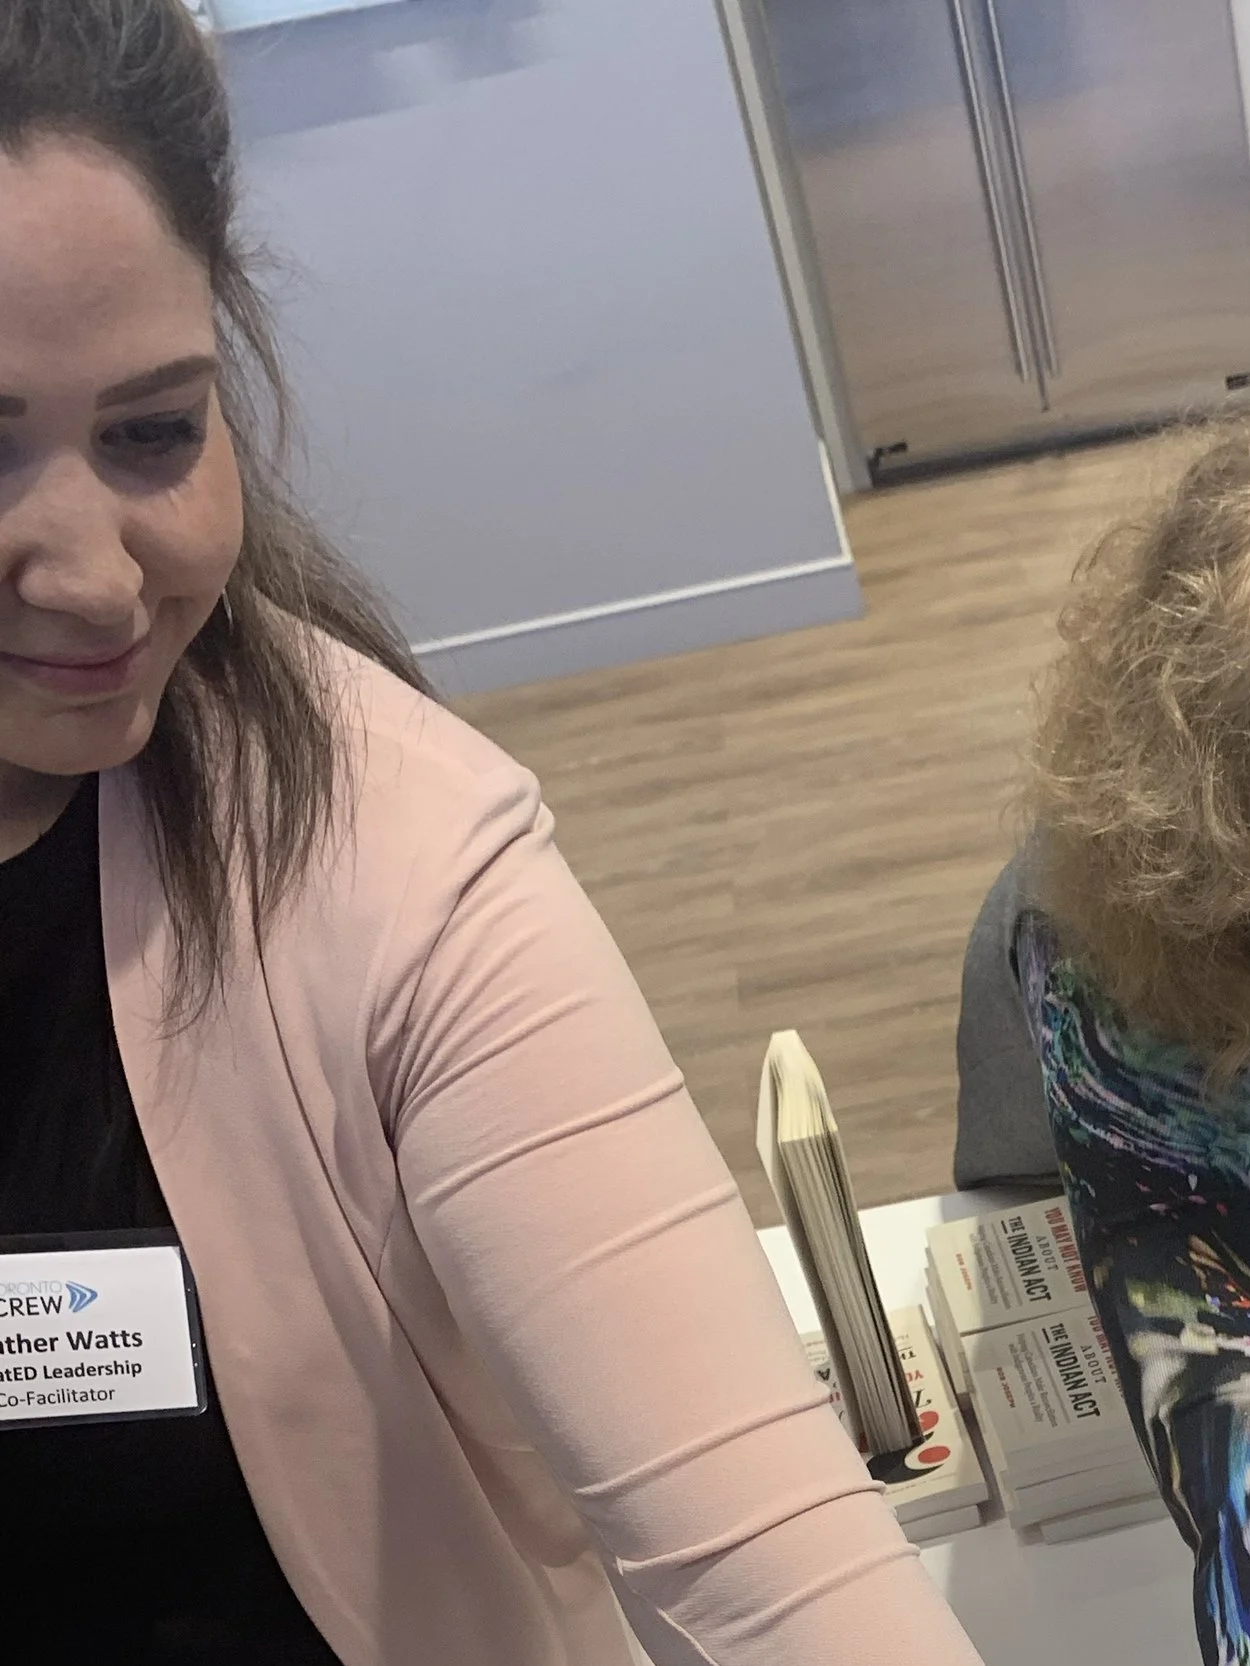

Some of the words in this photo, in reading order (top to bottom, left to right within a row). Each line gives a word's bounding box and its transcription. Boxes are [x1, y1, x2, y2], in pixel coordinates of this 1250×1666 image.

[1008, 1216, 1025, 1233] THE
[1044, 1206, 1064, 1225] YOU
[1051, 1224, 1073, 1244] MAY
[1007, 1233, 1041, 1277] INDIAN
[1035, 1235, 1059, 1271] ABOUT
[1058, 1243, 1080, 1262] NOT
[1066, 1263, 1088, 1293] KNOW
[1023, 1277, 1051, 1302] ACT
[0, 1295, 63, 1317] CREW
[66, 1330, 143, 1351] Watts
[1050, 1323, 1068, 1341] THE
[43, 1360, 142, 1378] Leadership
[1049, 1342, 1088, 1391] INDIAN
[1080, 1345, 1107, 1384] ABOUT
[0, 1388, 115, 1408] Co-Facilitator
[1069, 1392, 1100, 1419] ACT
